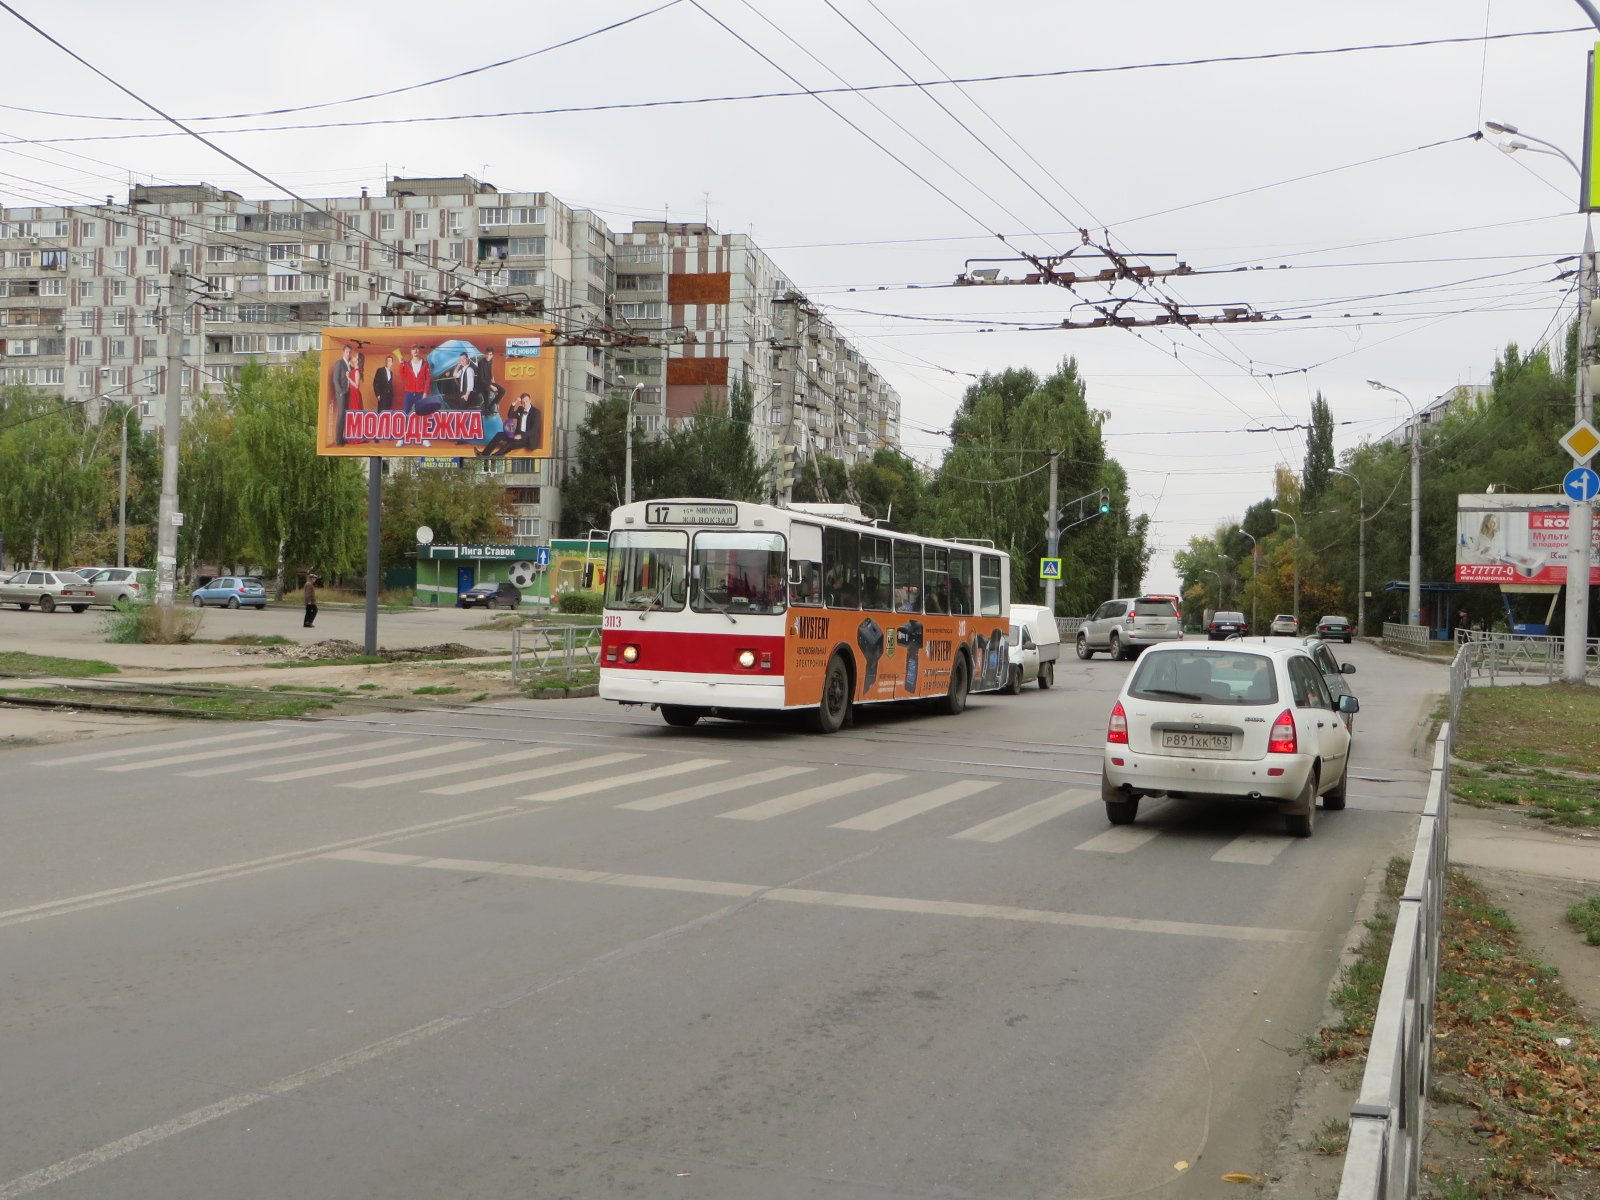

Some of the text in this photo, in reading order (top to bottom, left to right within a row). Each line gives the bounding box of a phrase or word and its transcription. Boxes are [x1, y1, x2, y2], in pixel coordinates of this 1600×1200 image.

[509, 365, 536, 377] СТС
[655, 506, 670, 523] 17
[461, 546, 516, 556] Лига Ставок
[1460, 565, 1514, 575] 2-77777-0
[604, 616, 622, 628] 3113
[799, 615, 830, 640] MYSTERY
[795, 659, 827, 668] ЭЛЕКТРОНИКА
[1211, 736, 1228, 746] 163
